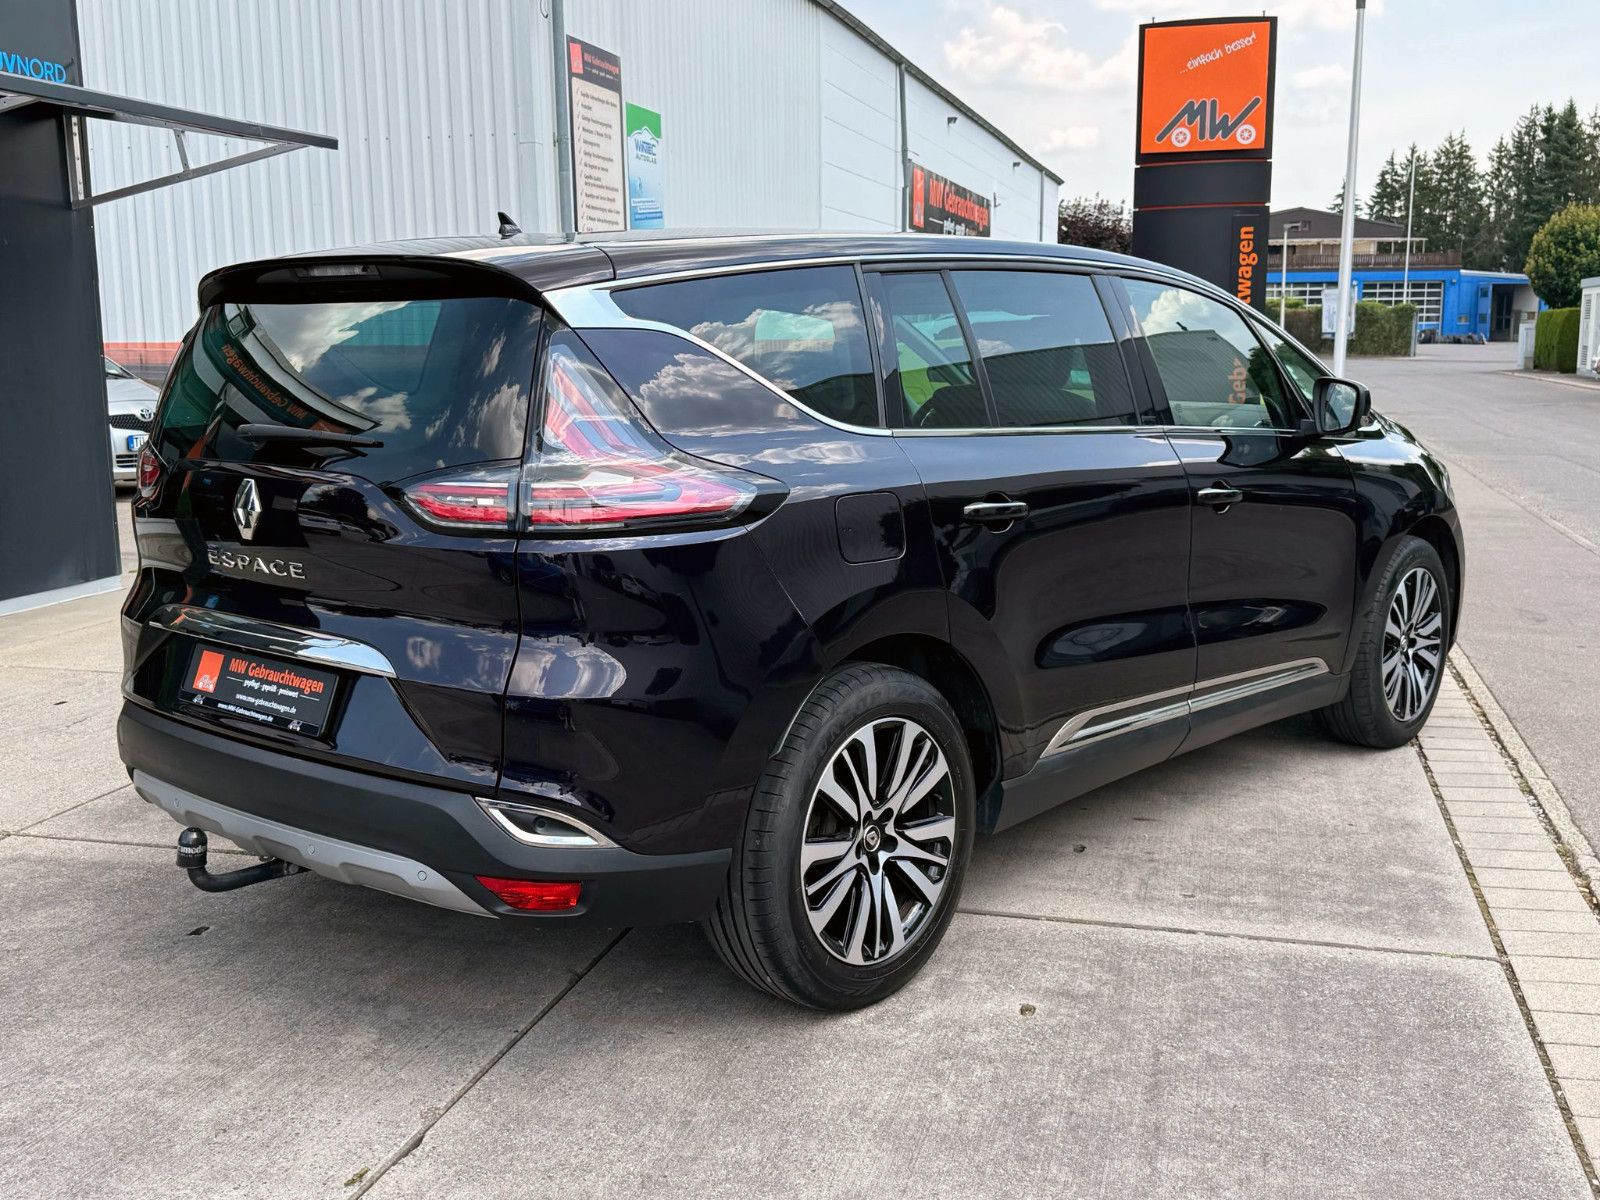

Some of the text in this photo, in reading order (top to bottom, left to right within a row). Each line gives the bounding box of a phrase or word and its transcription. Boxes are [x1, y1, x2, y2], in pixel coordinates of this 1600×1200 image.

[1224, 30, 1257, 54] besser!
[1154, 96, 1262, 143] MW
[207, 547, 306, 580] ESPACE
[229, 657, 324, 695] MW Gebrauchtwagen
